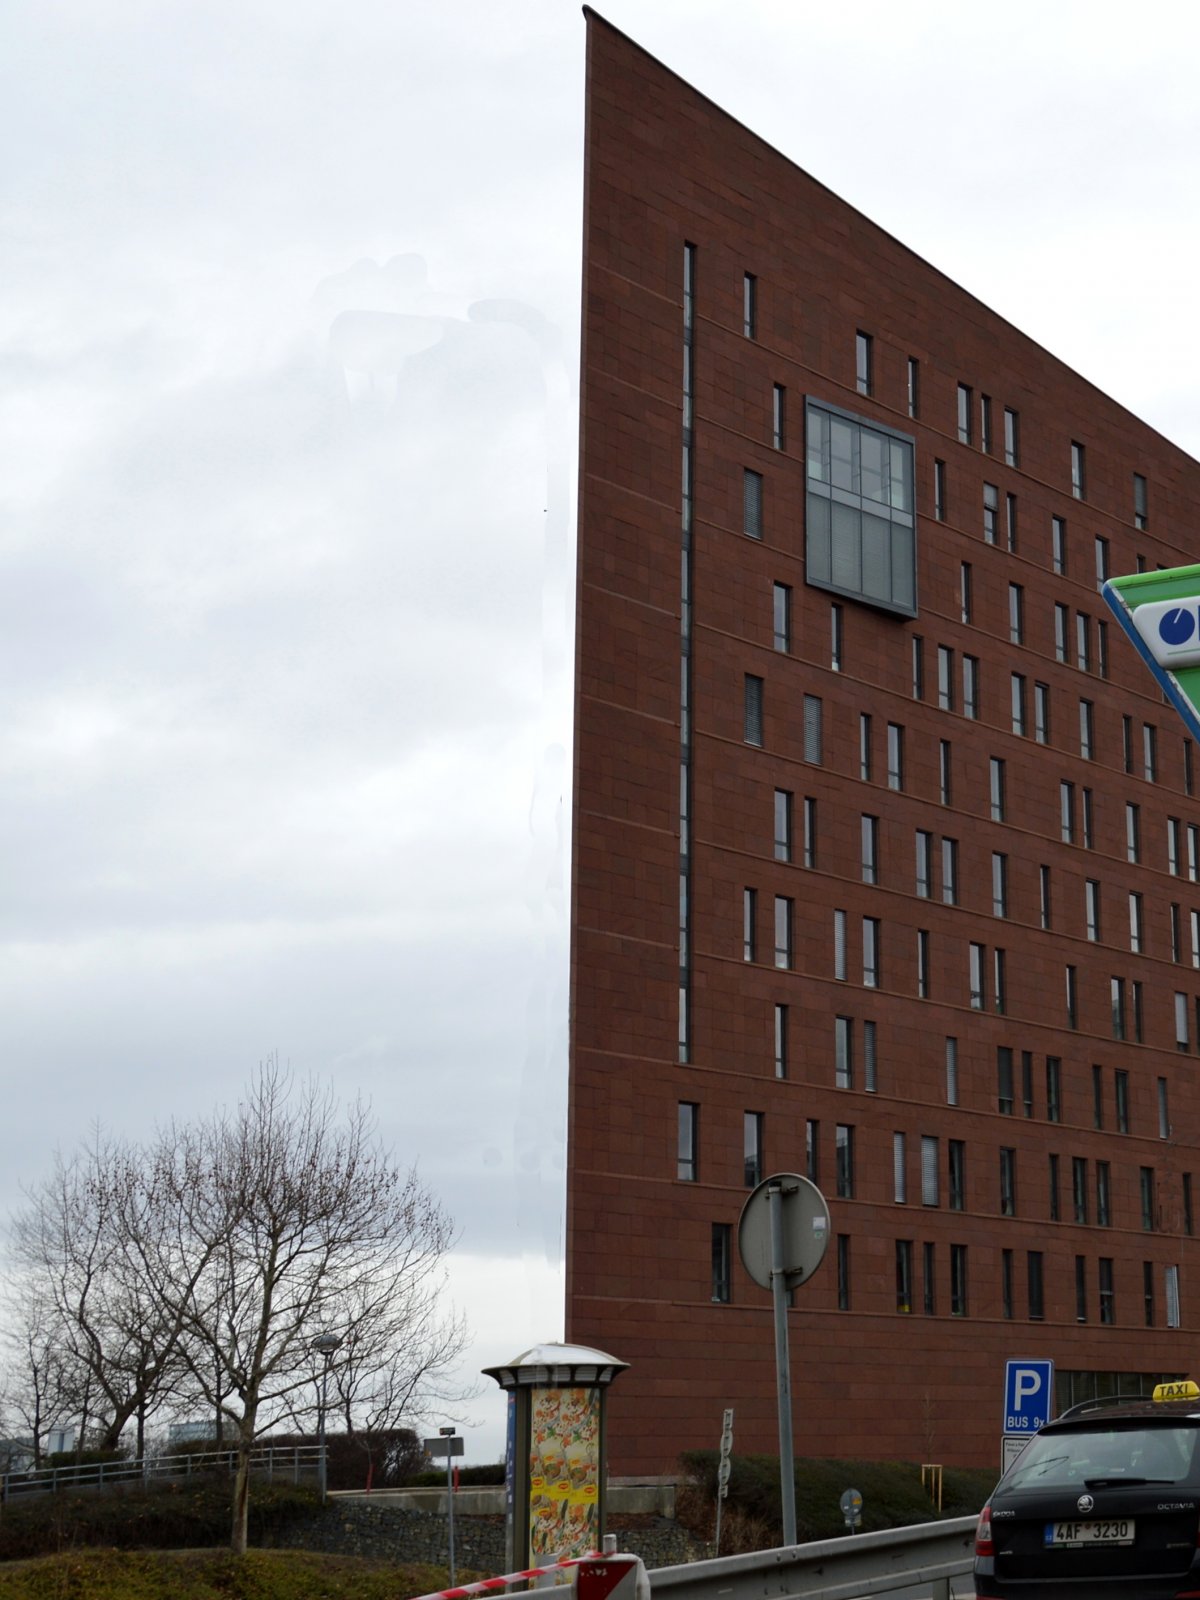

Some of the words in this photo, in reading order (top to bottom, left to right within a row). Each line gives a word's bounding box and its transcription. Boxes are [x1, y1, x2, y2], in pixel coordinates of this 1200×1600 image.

[1160, 1383, 1188, 1397] TAXI
[1007, 1416, 1029, 1428] BUS
[1157, 1502, 1195, 1511] OCTAVIA
[1056, 1522, 1082, 1540] 4AF
[1093, 1522, 1128, 1539] 3230
